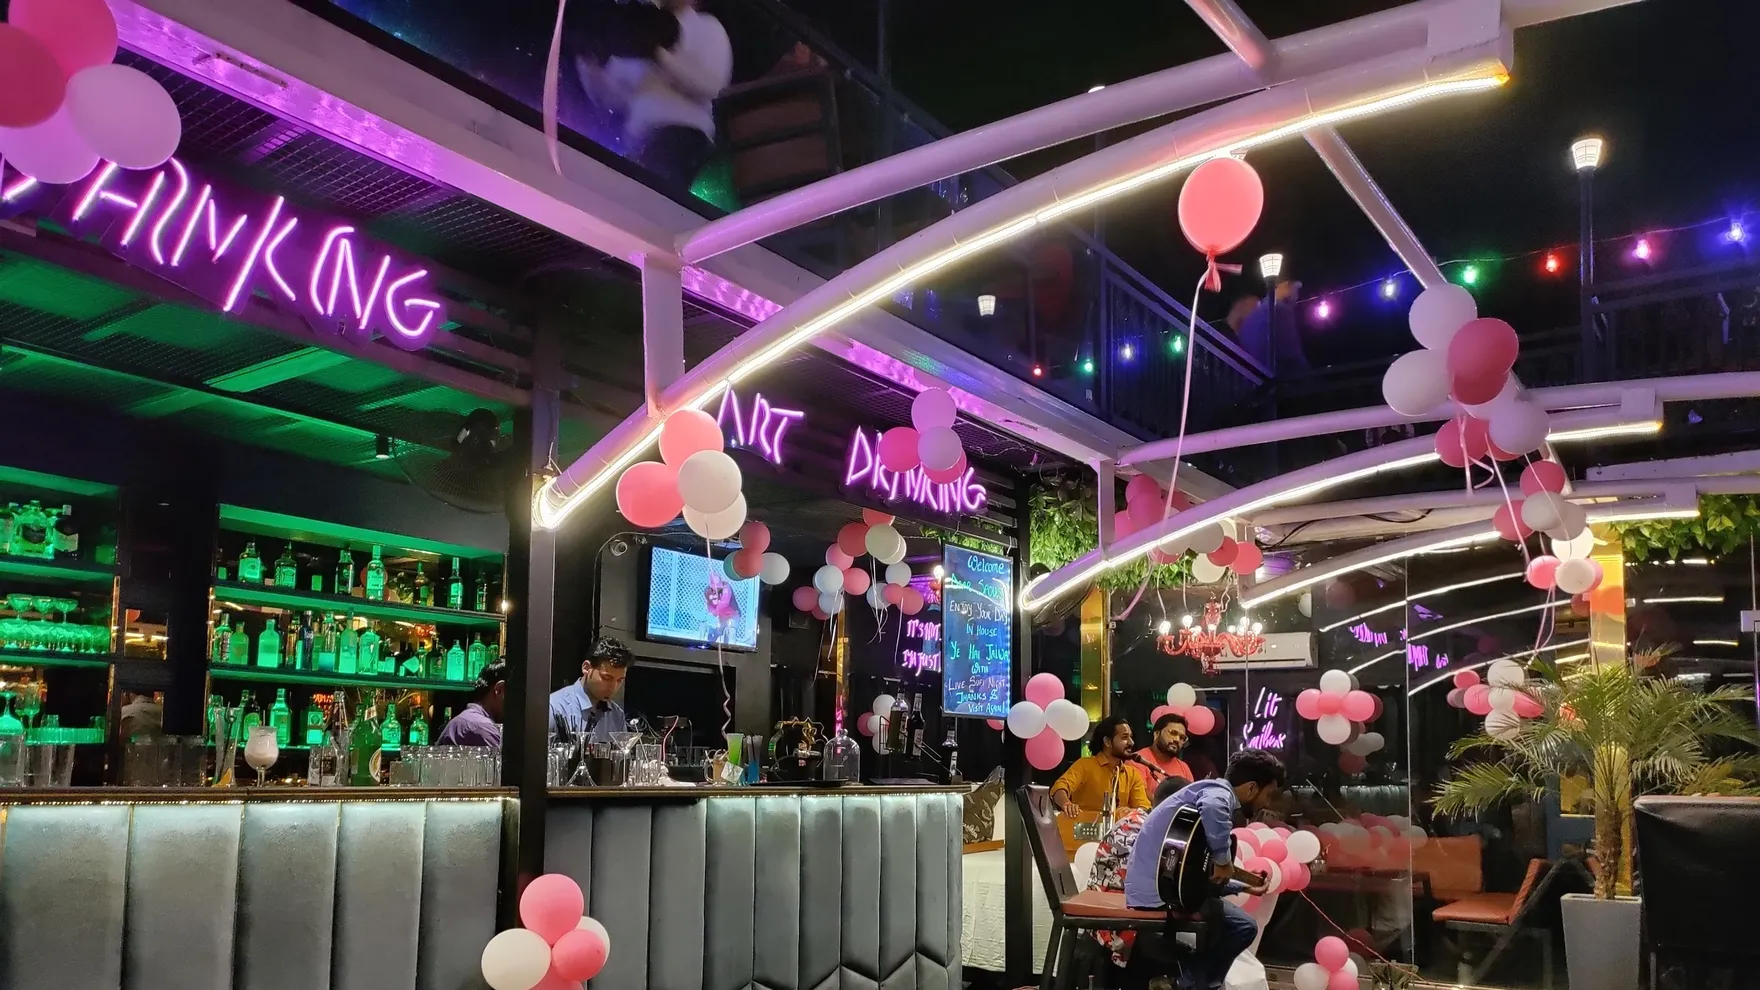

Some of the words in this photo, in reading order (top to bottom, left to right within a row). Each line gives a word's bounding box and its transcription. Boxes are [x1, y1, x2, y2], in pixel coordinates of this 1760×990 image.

[2, 157, 441, 337] HINKING
[967, 555, 1005, 575] Welcome
[976, 625, 998, 637] HOUSE
